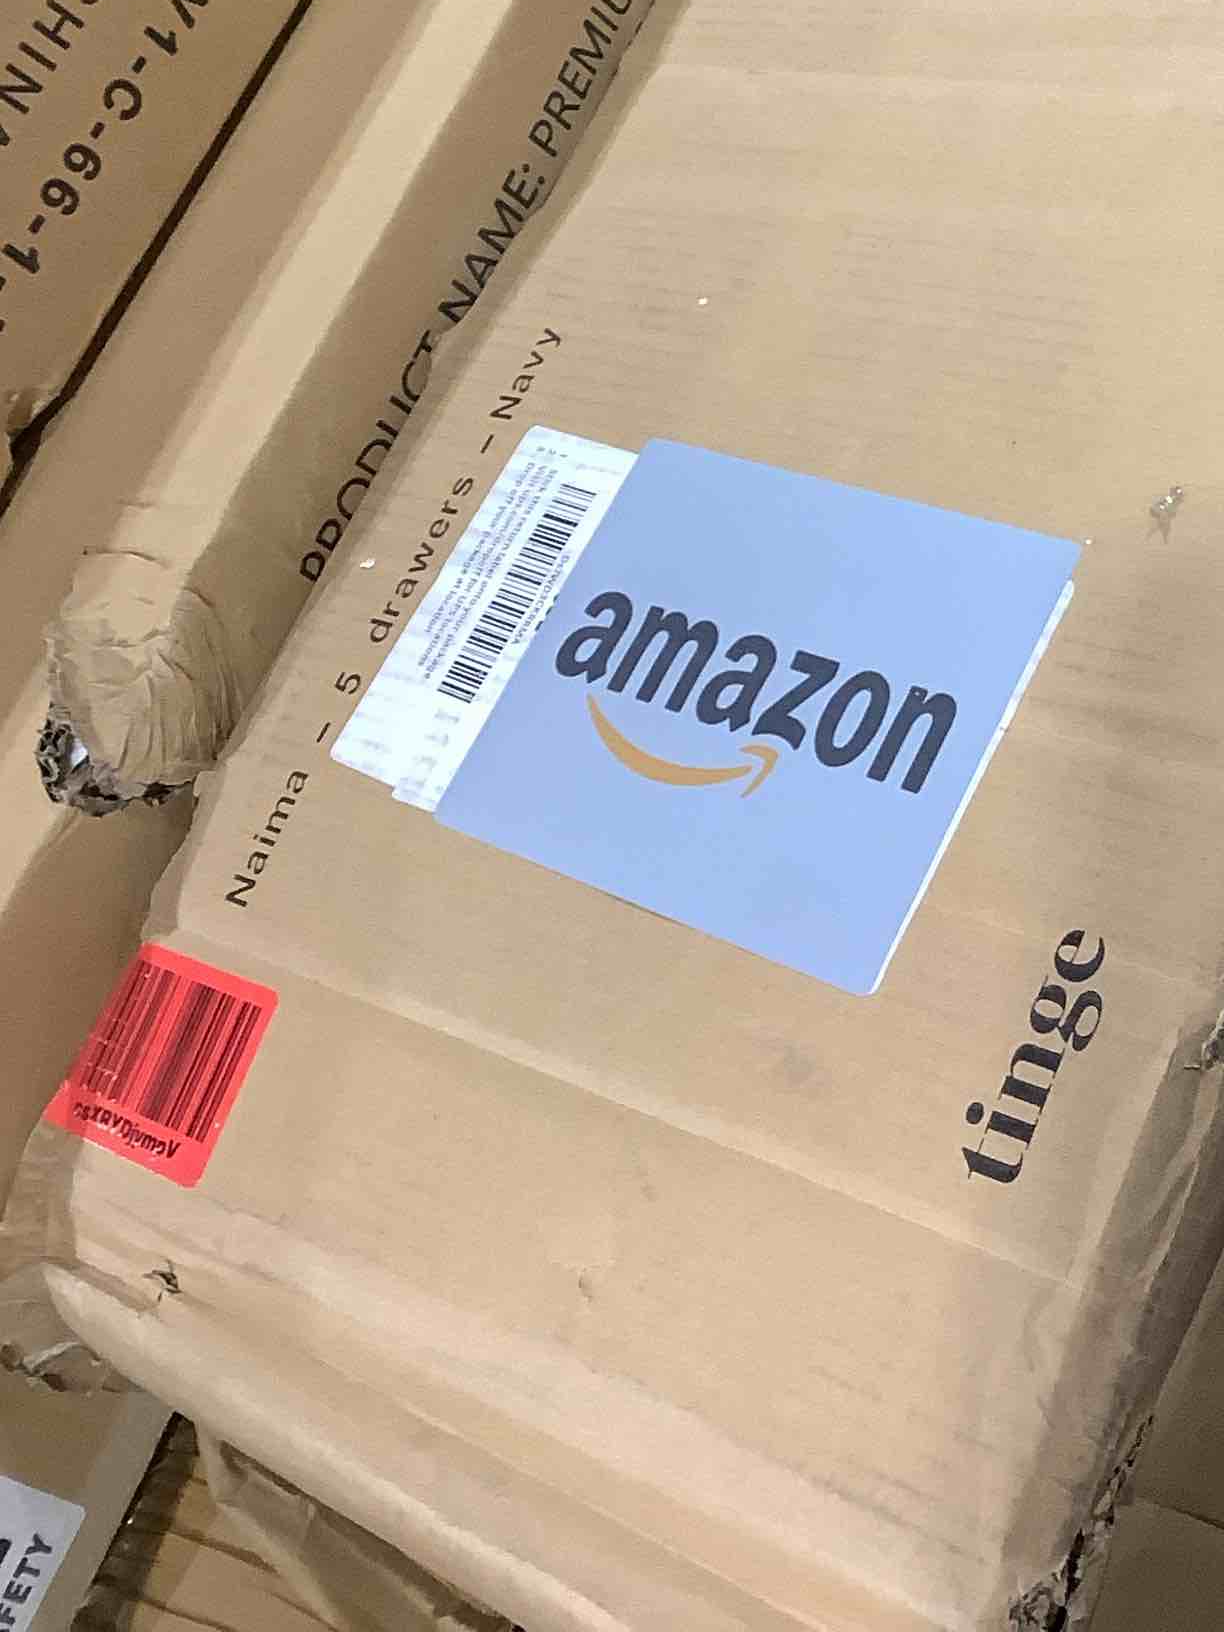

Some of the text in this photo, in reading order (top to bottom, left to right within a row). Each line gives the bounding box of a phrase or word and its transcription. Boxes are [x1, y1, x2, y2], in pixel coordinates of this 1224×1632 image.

[437, 163, 546, 325] NAME:
[225, 769, 308, 907] Naima
[335, 671, 363, 697] 5
[369, 474, 475, 643] drawers
[490, 327, 562, 420] Navy
[554, 591, 958, 795] amazon
[961, 929, 1105, 1183] tinge
[0, 1532, 53, 1632] FETY
